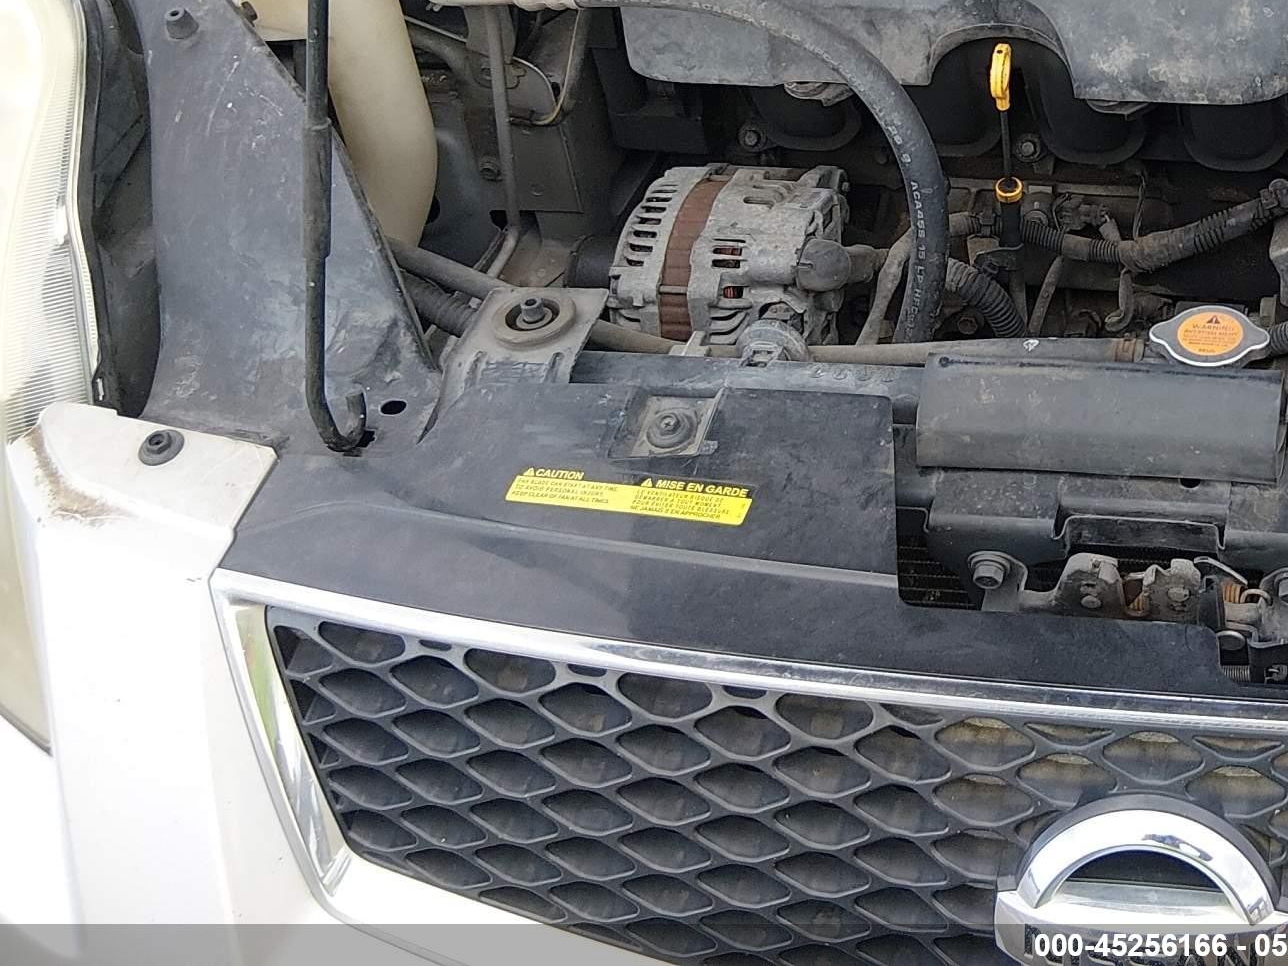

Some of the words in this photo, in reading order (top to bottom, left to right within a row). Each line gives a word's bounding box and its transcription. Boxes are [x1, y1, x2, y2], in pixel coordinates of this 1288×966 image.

[535, 468, 585, 481] CAUTION
[655, 479, 687, 491] MISE
[686, 482, 705, 493] EN
[705, 484, 750, 498] GARDE
